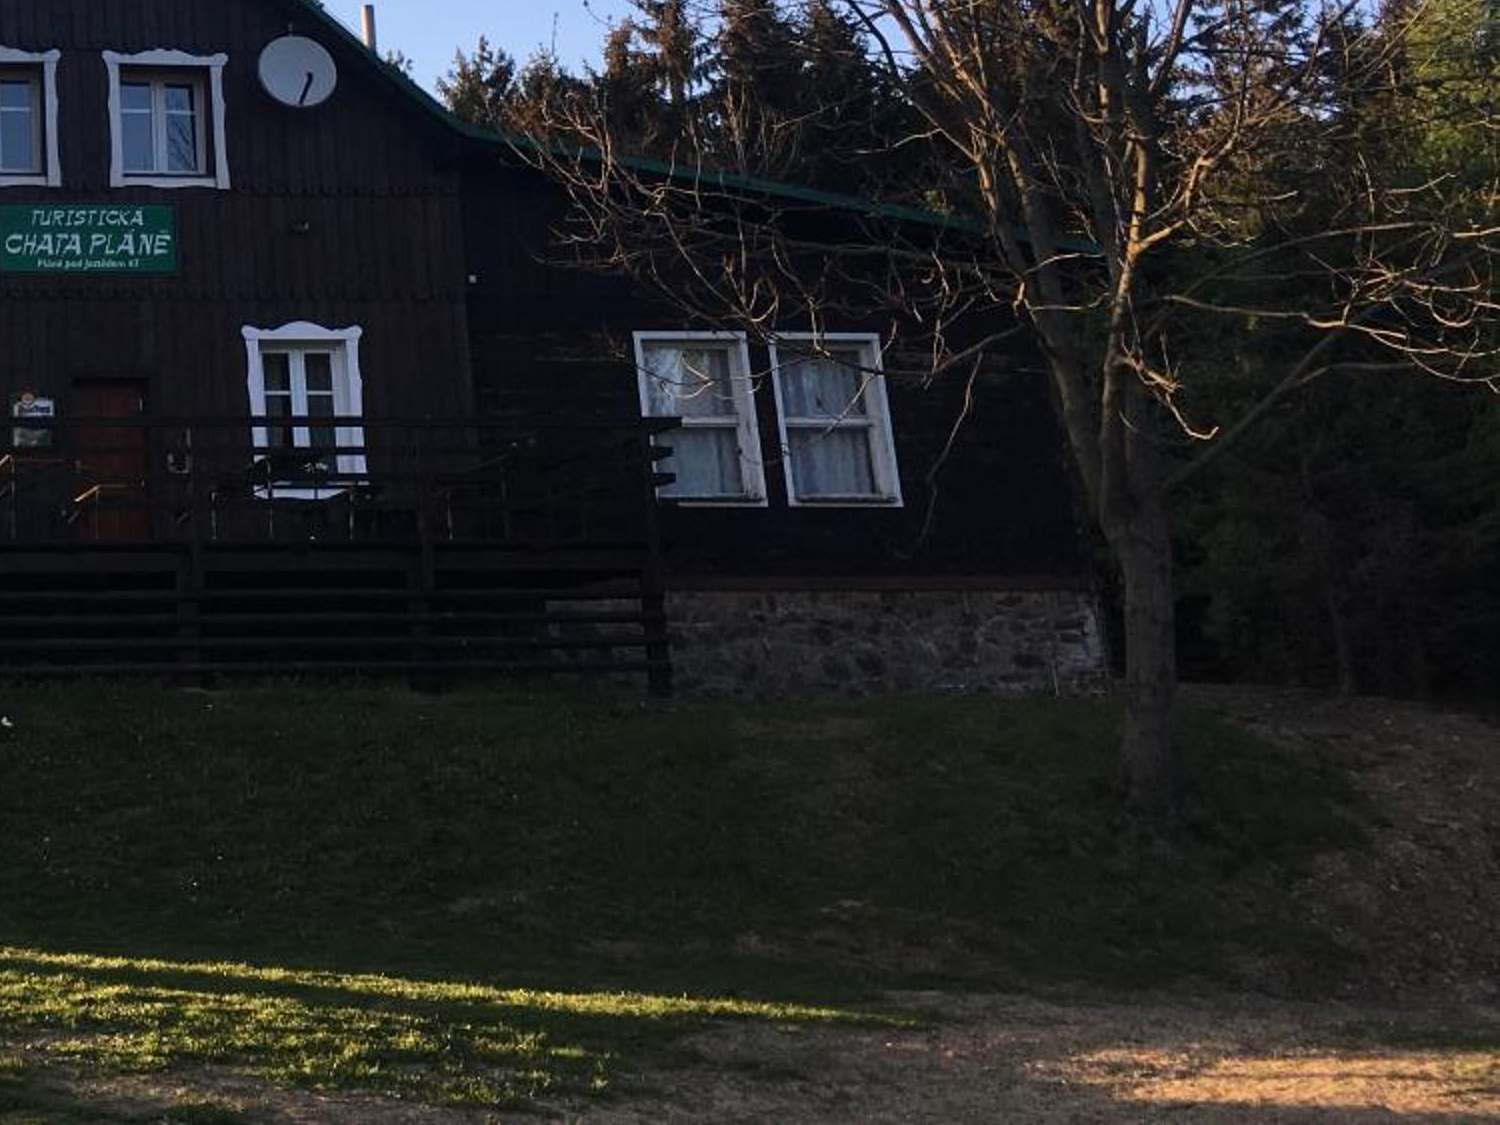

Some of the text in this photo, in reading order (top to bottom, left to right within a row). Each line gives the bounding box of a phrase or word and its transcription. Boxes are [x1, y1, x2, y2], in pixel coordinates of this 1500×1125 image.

[31, 206, 145, 226] TURISTICKÁ
[4, 228, 172, 256] CHATA PLÁNĚ
